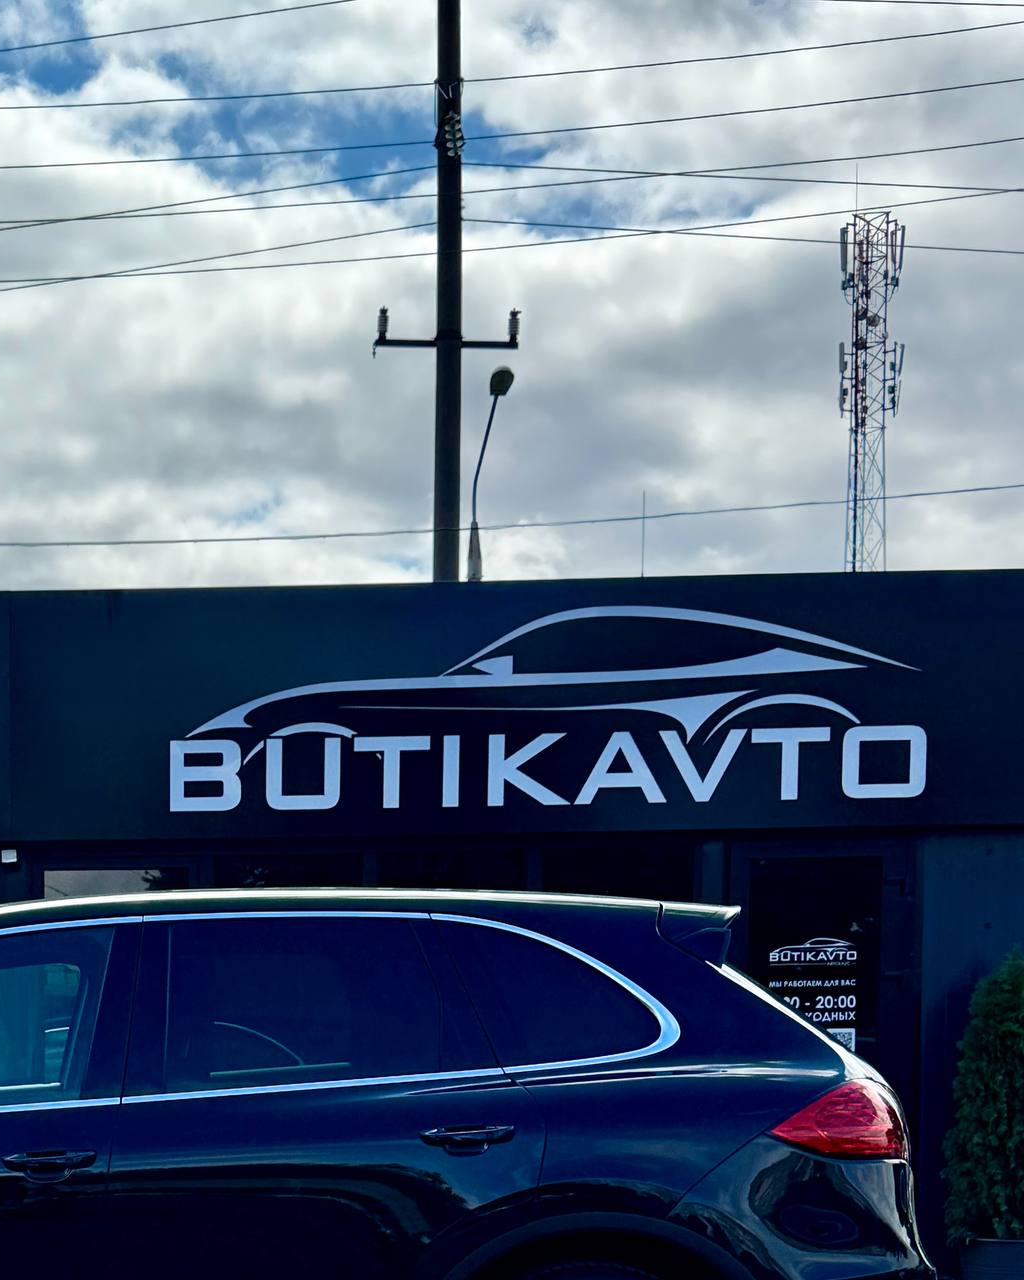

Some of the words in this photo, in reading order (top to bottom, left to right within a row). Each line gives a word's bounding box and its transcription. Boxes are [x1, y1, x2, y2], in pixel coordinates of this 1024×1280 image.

[169, 724, 928, 812] BUTIKAVTO
[769, 950, 858, 962] BUTIKAVTO
[784, 980, 822, 988] РАБОТАЕМ
[815, 995, 857, 1009] 20:00
